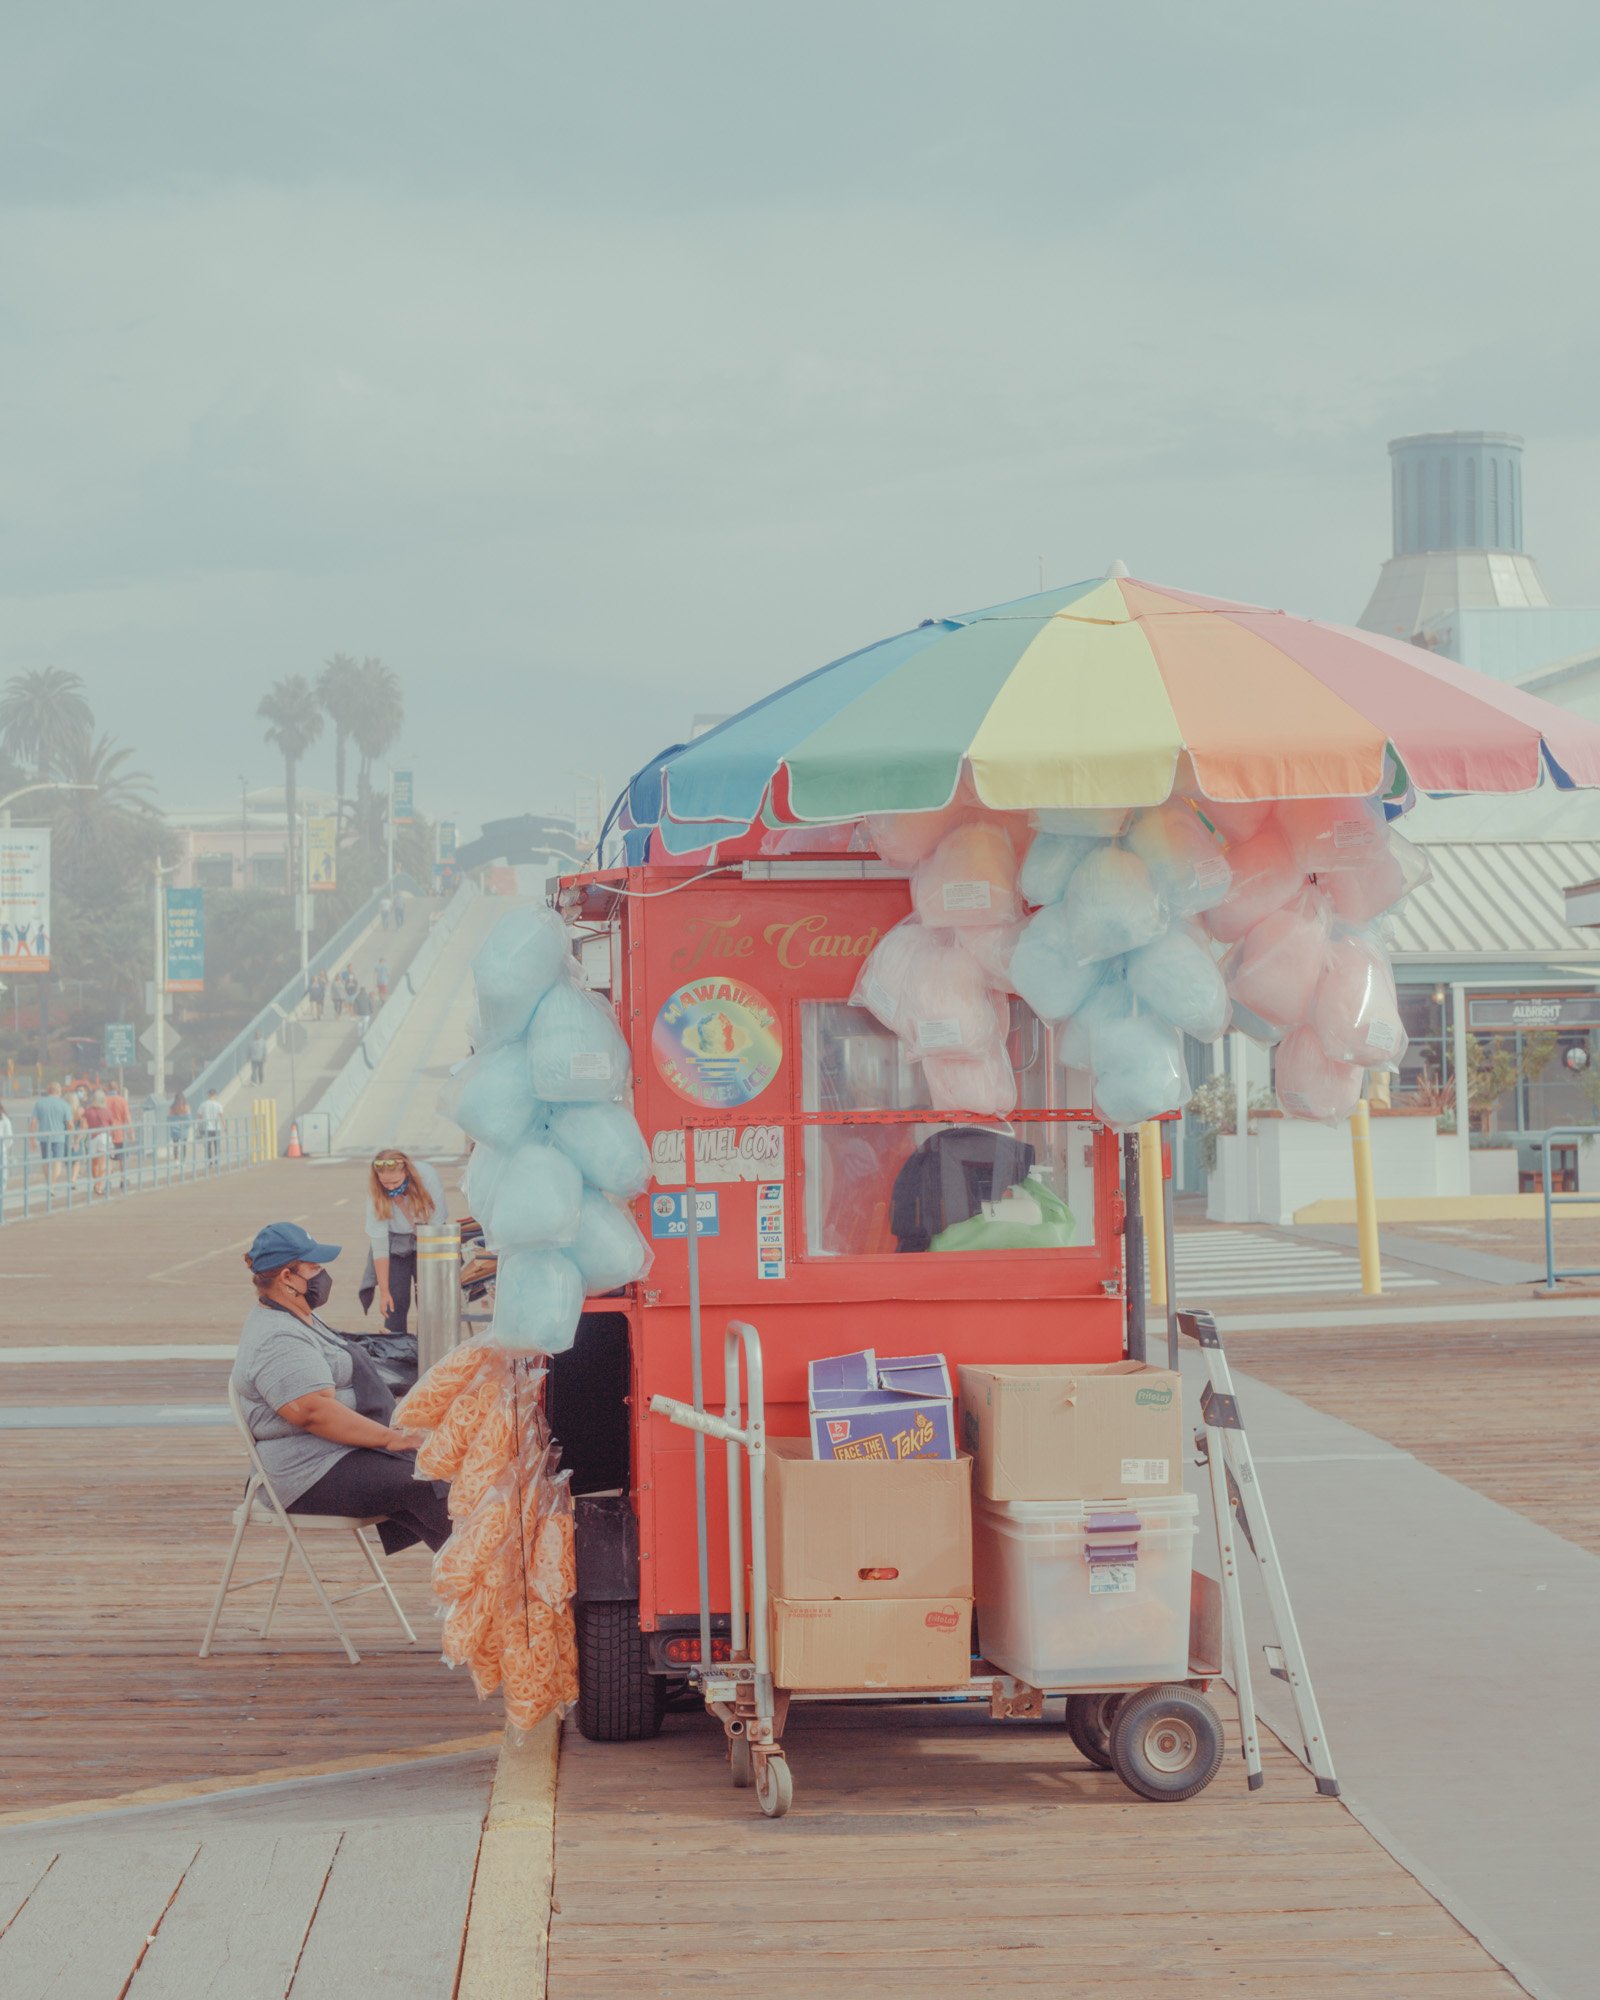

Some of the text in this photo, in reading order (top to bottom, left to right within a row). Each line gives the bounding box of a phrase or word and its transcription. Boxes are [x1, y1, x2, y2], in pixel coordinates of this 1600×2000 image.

[168, 918, 195, 928] YOUR
[168, 929, 202, 938] LOCAL
[670, 914, 884, 974] The Cand
[663, 984, 776, 1029] HAWAIIAN
[1512, 1005, 1562, 1018] ALBRIGHT
[742, 1062, 772, 1092] ICE
[667, 1221, 704, 1233] 209
[838, 1444, 862, 1460] FACE
[863, 1438, 882, 1454] THE
[891, 1421, 934, 1460] Takis
